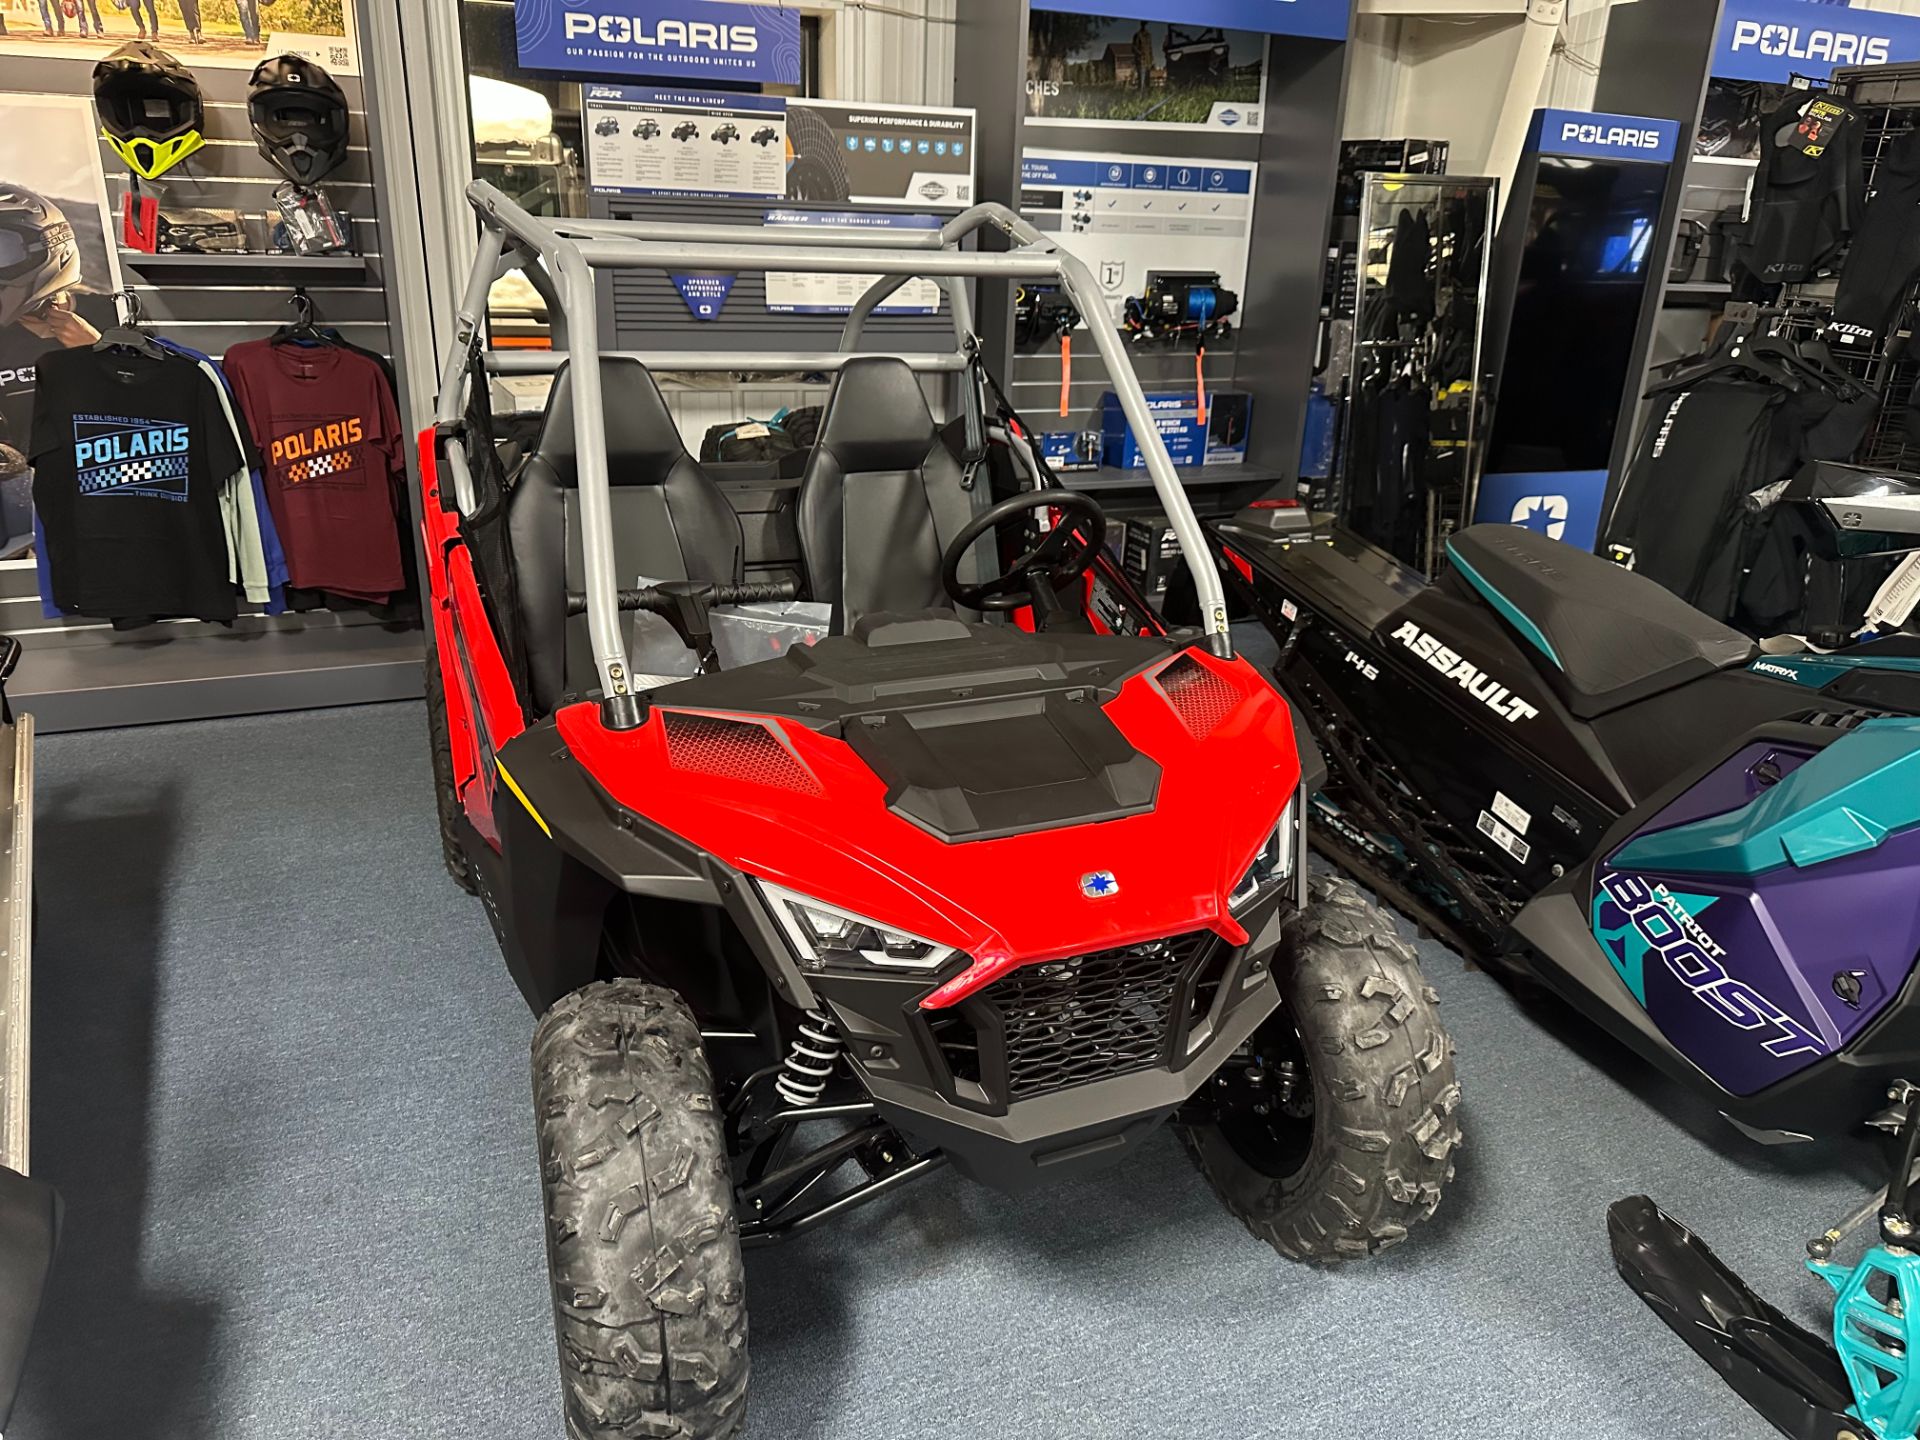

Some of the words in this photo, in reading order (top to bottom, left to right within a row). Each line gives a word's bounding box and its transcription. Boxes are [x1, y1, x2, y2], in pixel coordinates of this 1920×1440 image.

[564, 11, 758, 53] POLARIS
[1731, 20, 1890, 65] POLARIS
[566, 48, 583, 56] OUR
[587, 49, 624, 58] PASSION
[628, 52, 644, 60] FOR
[648, 53, 663, 61] THE
[667, 54, 710, 64] OUTDOORS
[713, 57, 742, 67] UNITES
[746, 60, 756, 68] US
[848, 115, 878, 124] SUPERIOR
[879, 117, 922, 127] PERFORMANCE
[929, 120, 964, 129] DURABILITY
[1561, 123, 1660, 149] POLARIS
[72, 414, 128, 423] ESTABLISHED
[130, 417, 151, 425] 1954
[1652, 391, 1691, 458] POLARIS
[75, 427, 189, 468] POLARIS
[271, 417, 362, 466] POLARIS
[1344, 651, 1379, 680] 146
[1390, 621, 1539, 722] ASSAULT
[1752, 661, 1798, 680] MATRYX
[1654, 883, 1727, 957] PATRIOT
[1599, 872, 1826, 1058] BOOST
